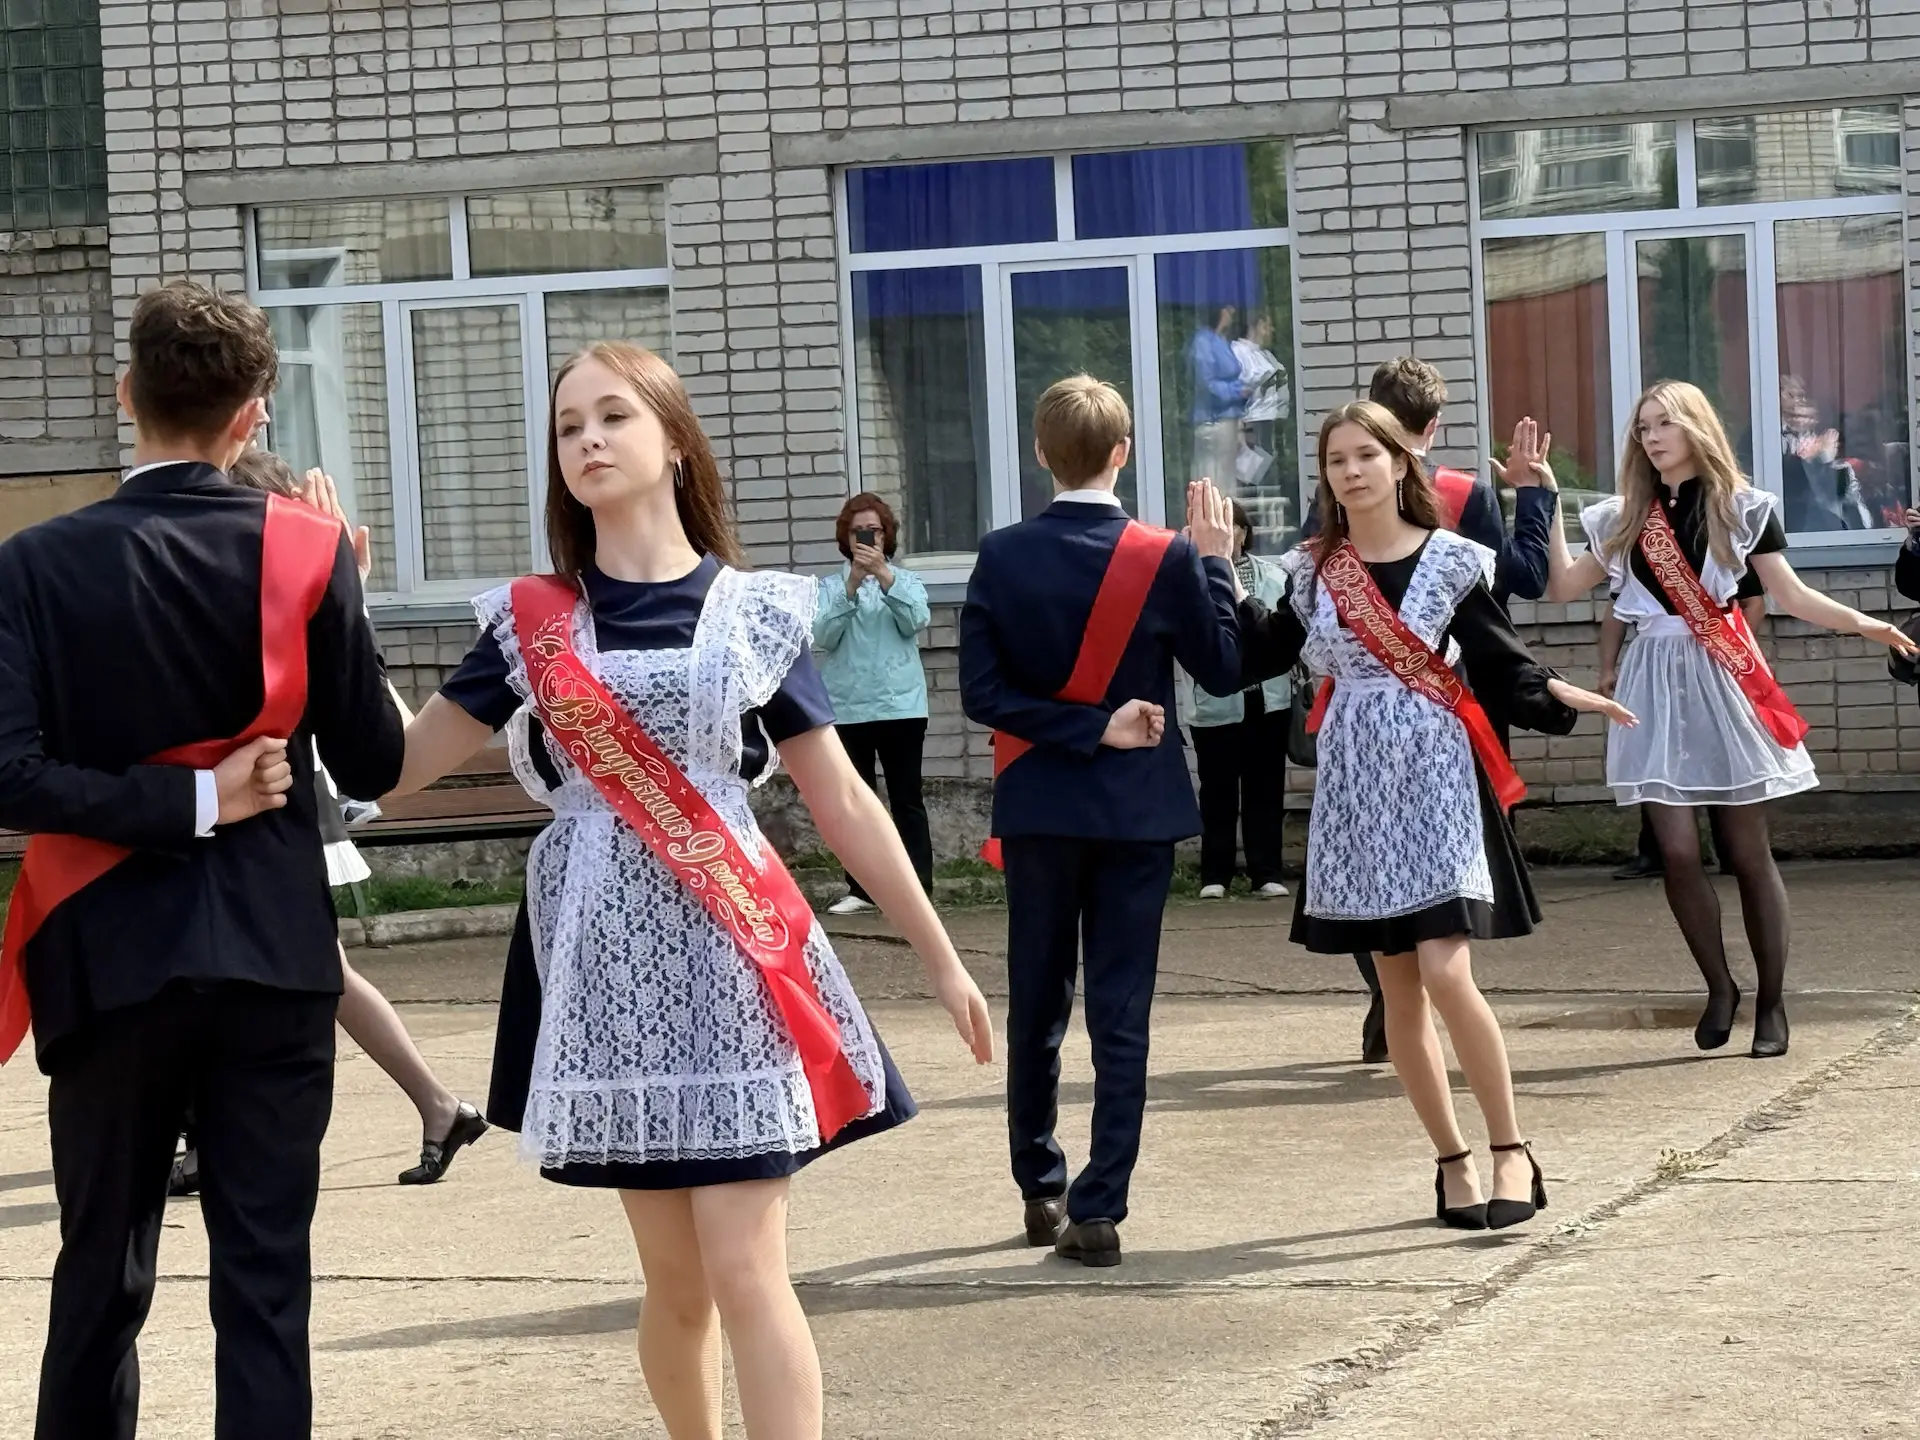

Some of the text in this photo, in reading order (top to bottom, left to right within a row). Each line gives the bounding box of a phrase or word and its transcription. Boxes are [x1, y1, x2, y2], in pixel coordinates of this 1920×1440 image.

[1394, 652, 1429, 674] 9
[538, 661, 774, 941] Выпускник 9 класса
